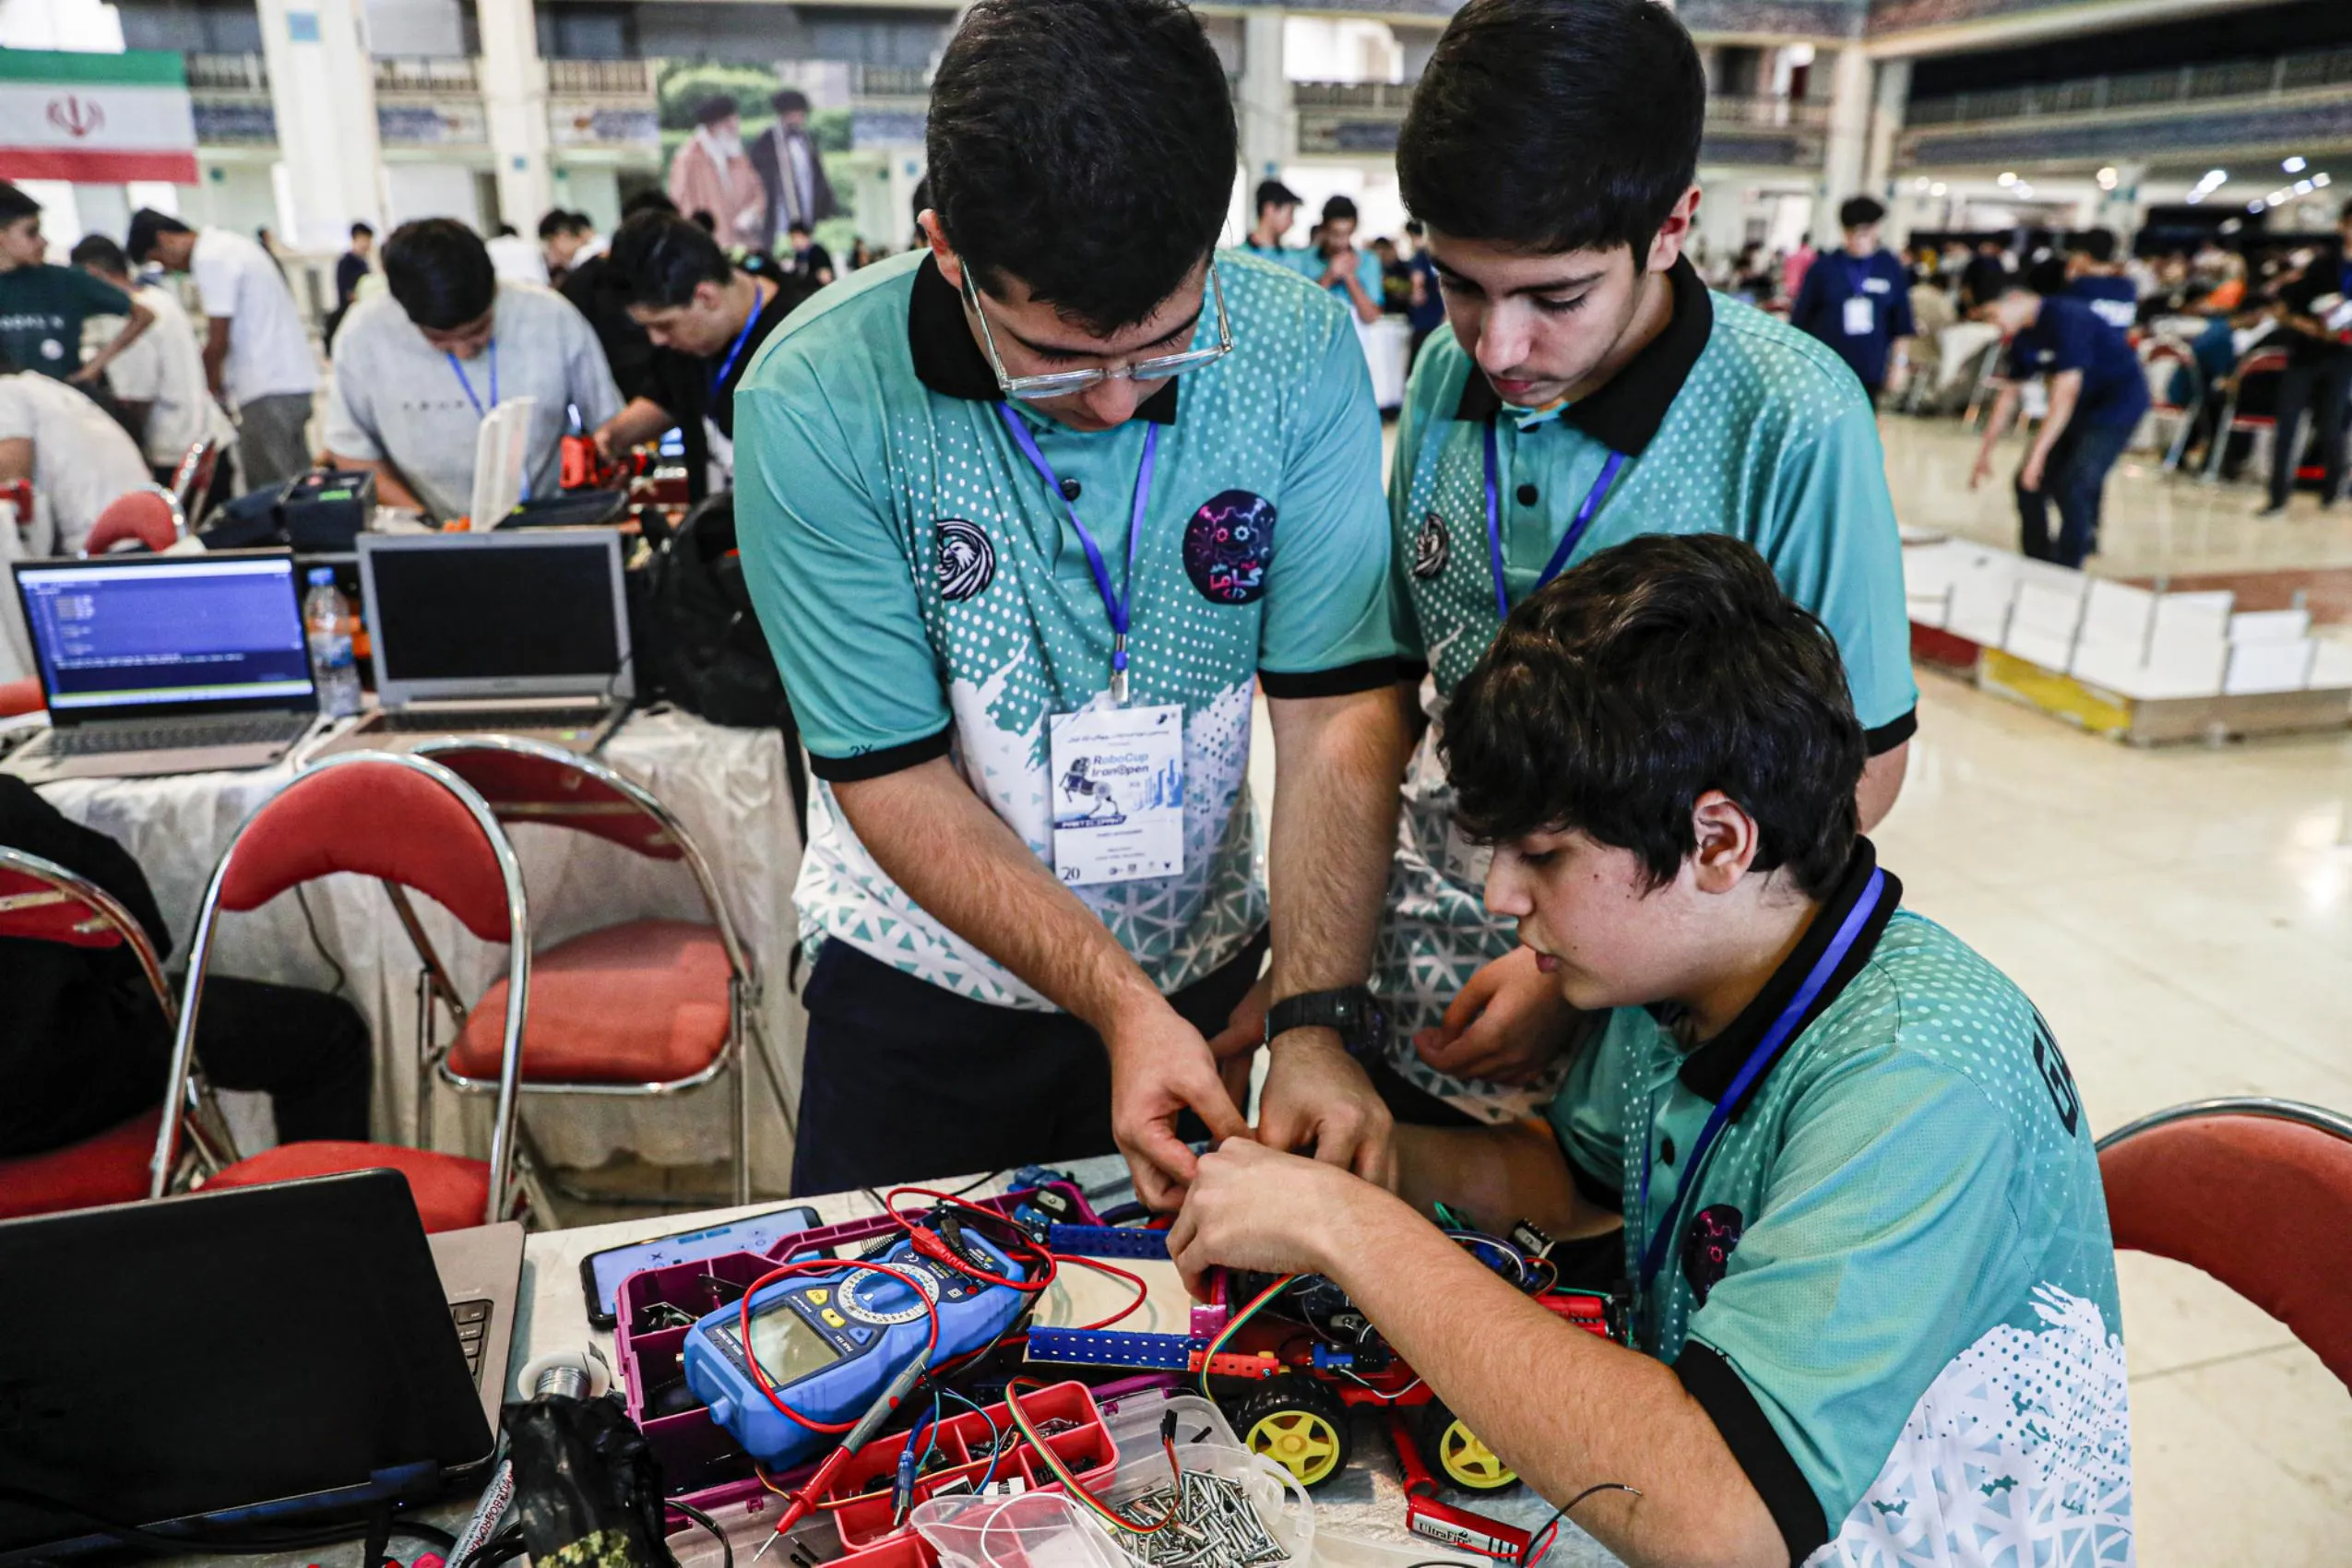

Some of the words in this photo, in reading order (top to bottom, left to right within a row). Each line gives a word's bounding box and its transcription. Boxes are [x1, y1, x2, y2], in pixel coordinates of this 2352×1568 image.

[1094, 753, 1149, 765] RoboCup
[1061, 866, 1081, 881] 20
[1419, 1522, 1469, 1545] UltraFire
